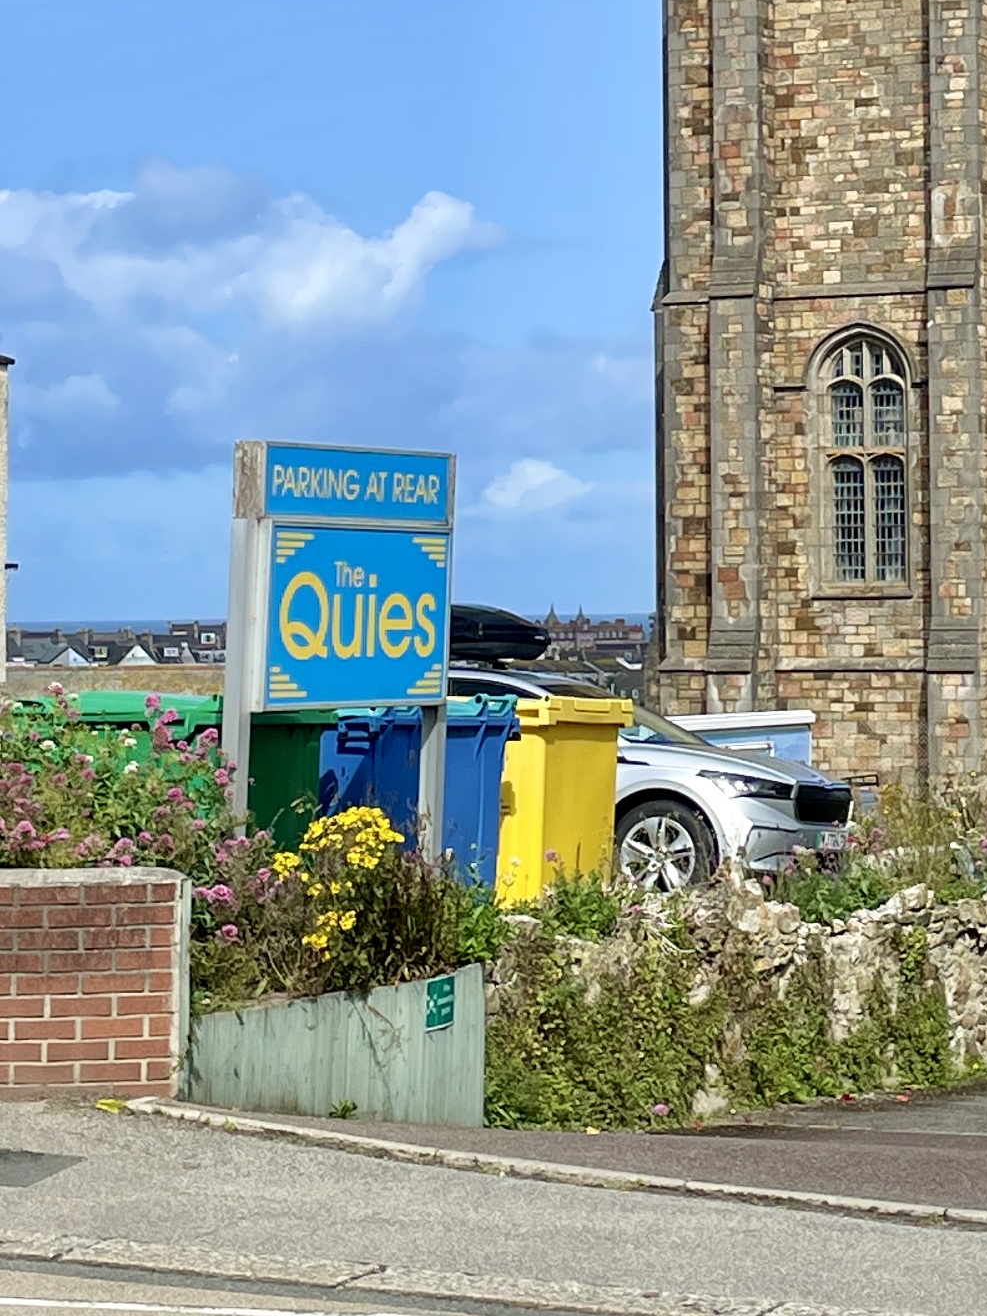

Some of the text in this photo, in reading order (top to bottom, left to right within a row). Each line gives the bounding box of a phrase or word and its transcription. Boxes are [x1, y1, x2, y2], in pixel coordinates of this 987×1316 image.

[272, 464, 440, 505] PARKING AT REAR
[334, 561, 365, 588] The
[279, 571, 436, 660] Quies
